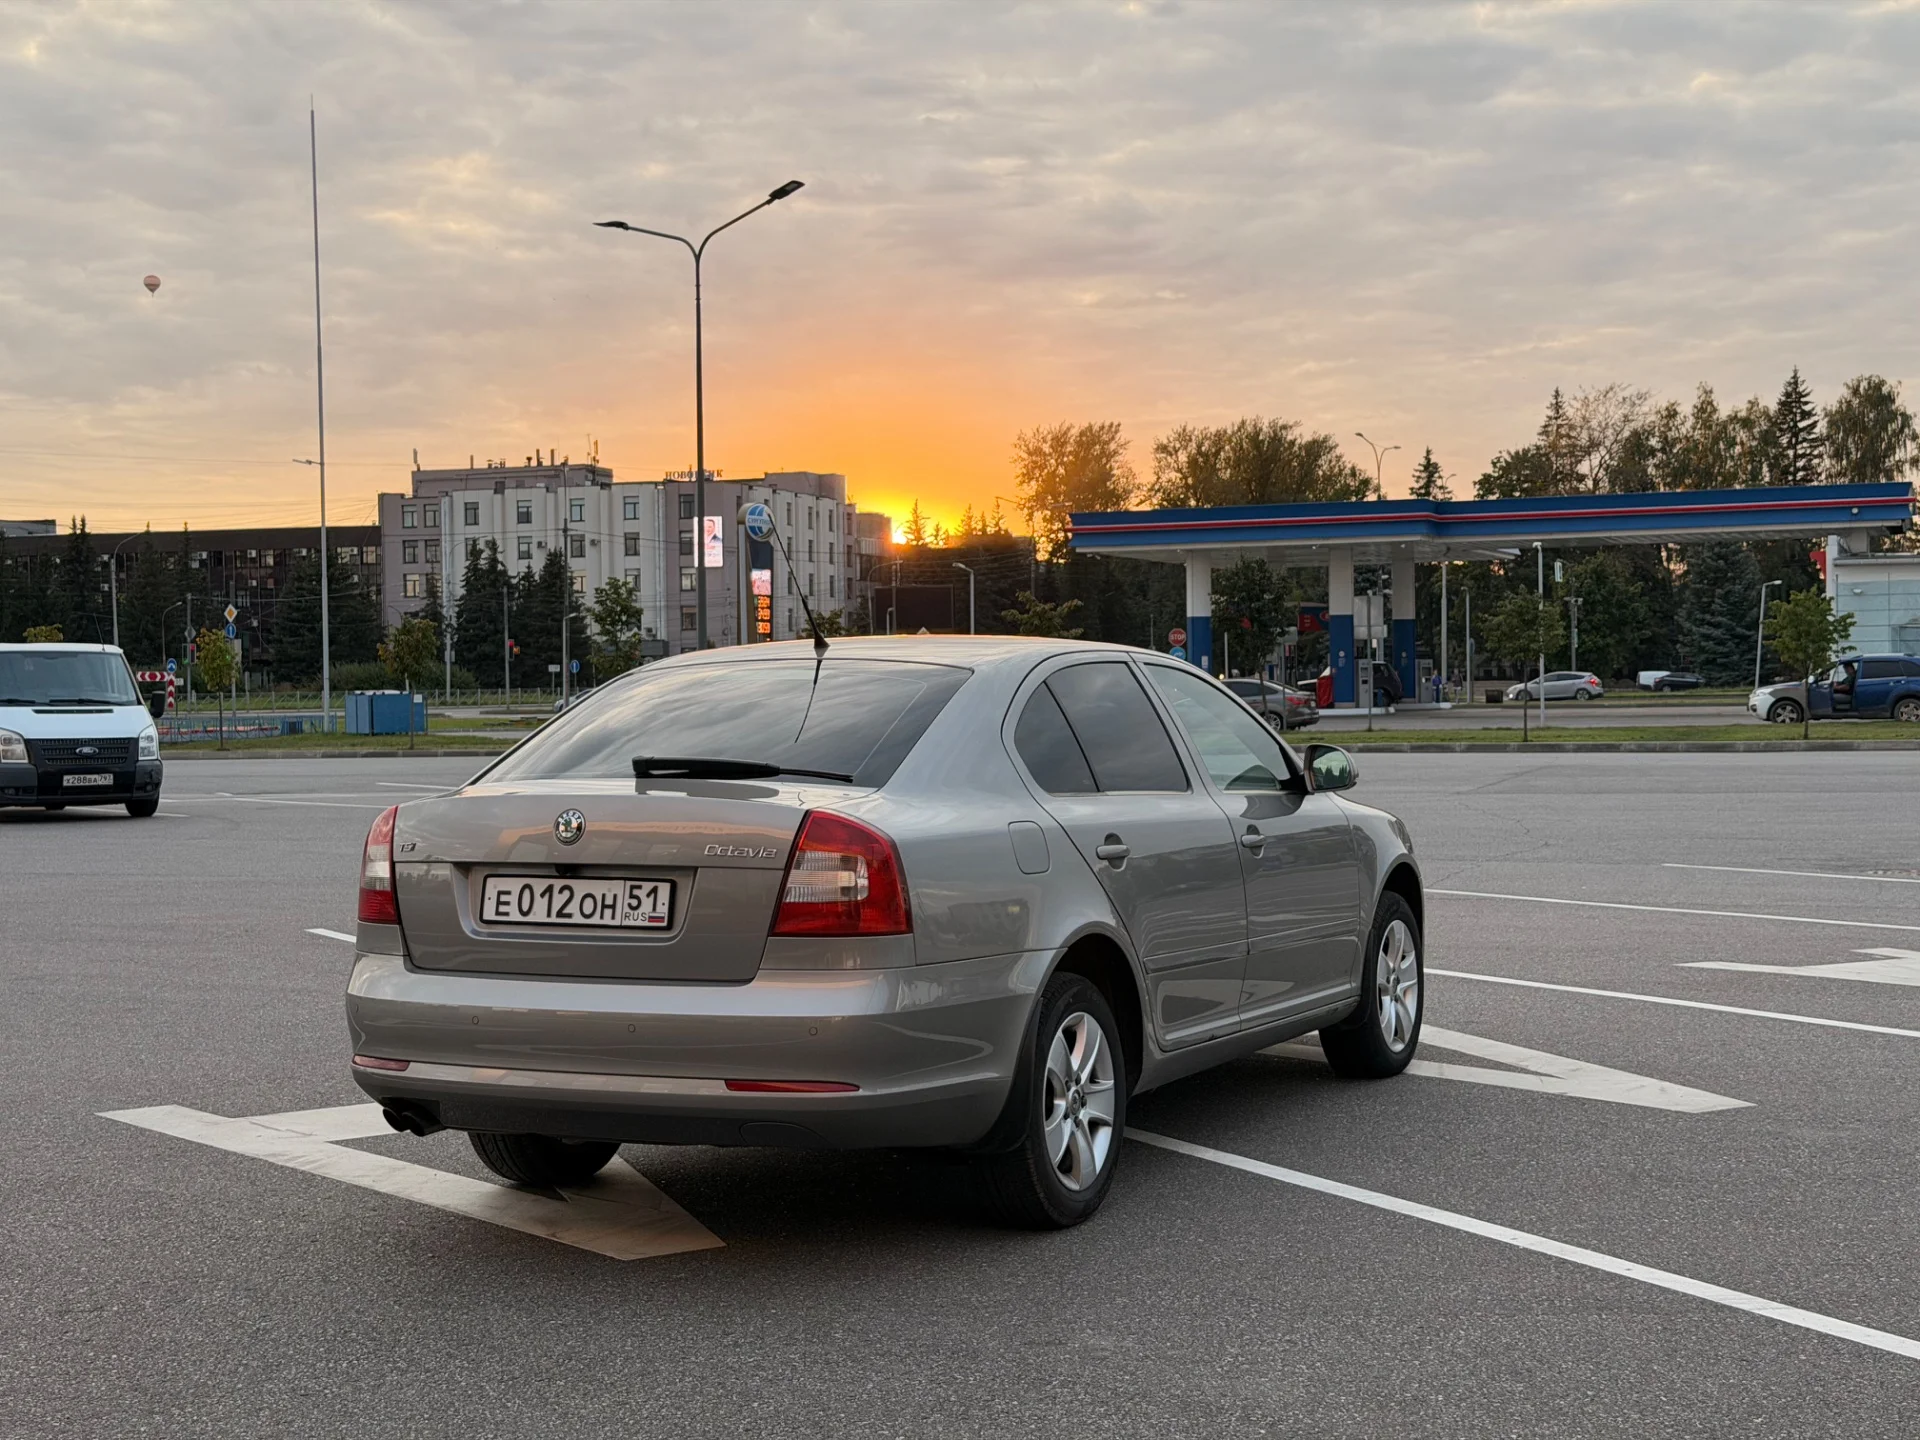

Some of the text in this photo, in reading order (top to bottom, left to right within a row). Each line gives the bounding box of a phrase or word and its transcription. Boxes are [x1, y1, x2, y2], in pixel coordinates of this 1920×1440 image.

[704, 844, 777, 858] Octavia
[494, 883, 659, 921] Е012ОН 51
[624, 911, 648, 922] RUS
